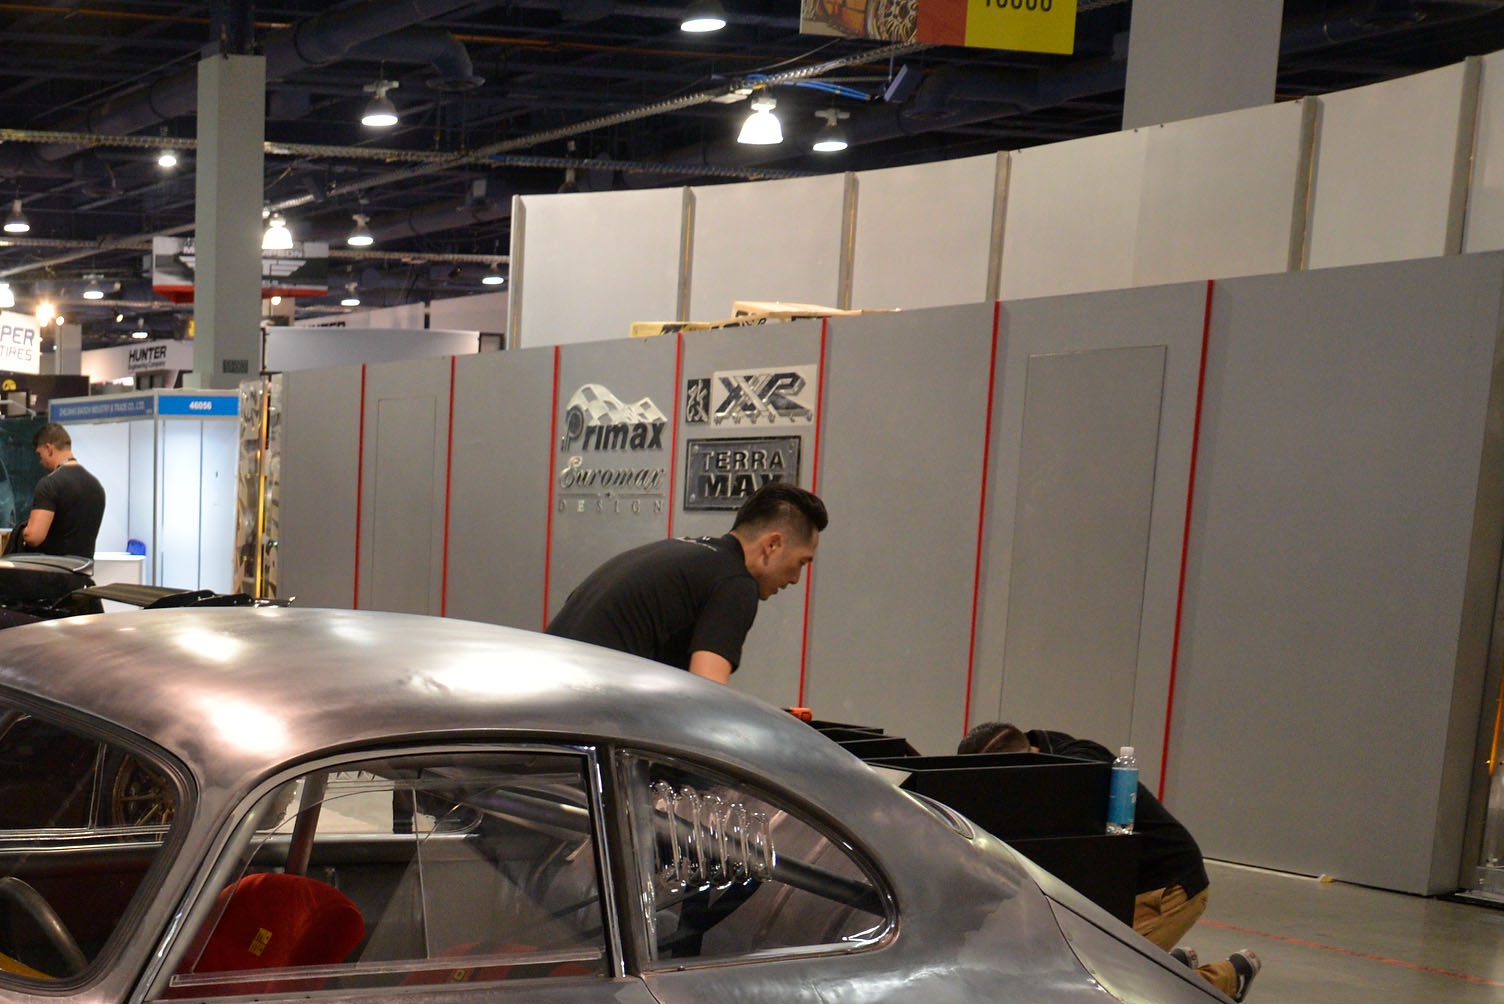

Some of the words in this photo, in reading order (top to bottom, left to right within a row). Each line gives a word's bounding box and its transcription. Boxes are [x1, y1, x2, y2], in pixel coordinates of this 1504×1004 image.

[0, 344, 33, 362] TIRES
[128, 345, 167, 363] HUNTER
[561, 404, 665, 452] Primax
[703, 450, 786, 472] TERRA
[560, 456, 665, 490] Euromax
[558, 499, 664, 513] DESIGN
